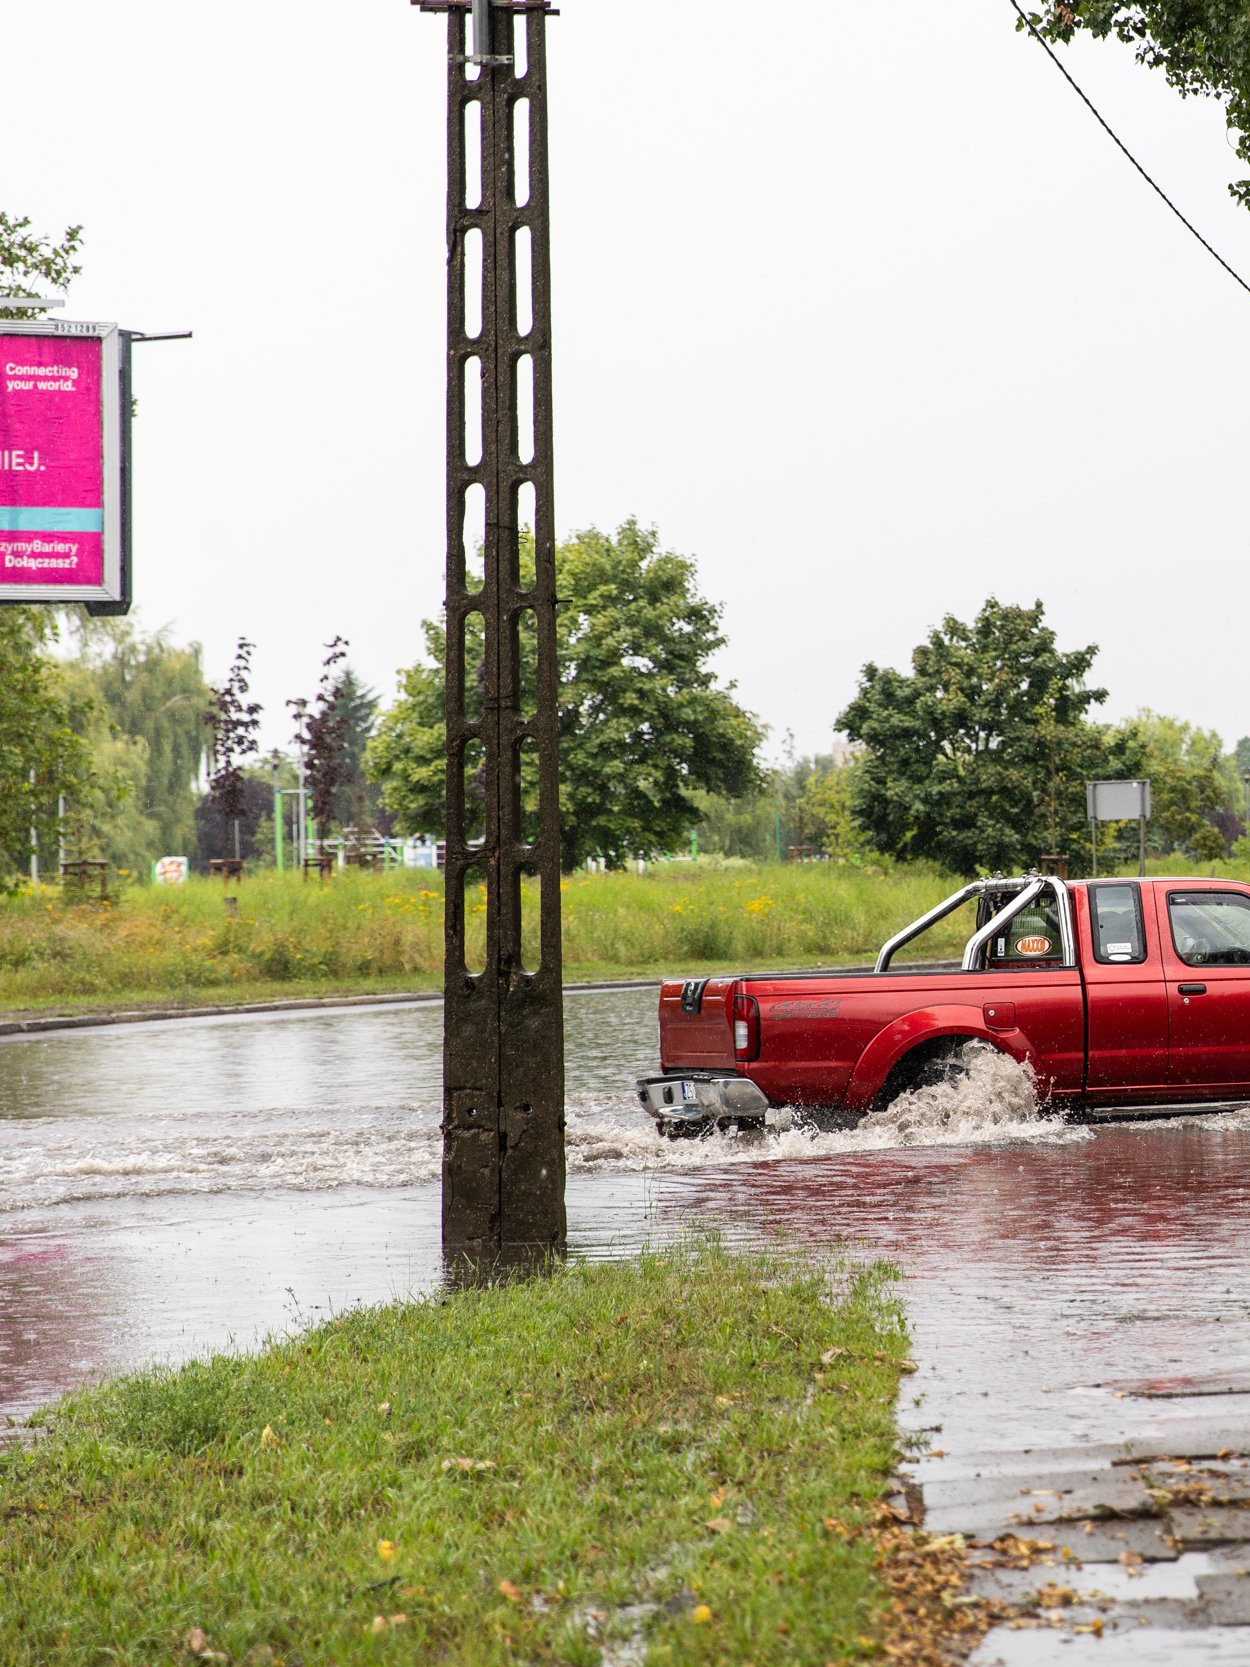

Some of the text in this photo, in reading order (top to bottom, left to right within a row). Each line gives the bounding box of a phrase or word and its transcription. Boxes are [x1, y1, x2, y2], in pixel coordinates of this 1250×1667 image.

[6, 362, 78, 379] Connecting
[6, 379, 76, 392] your world.
[0, 450, 46, 471] IEJ.
[5, 555, 78, 570] Dołączasz?
